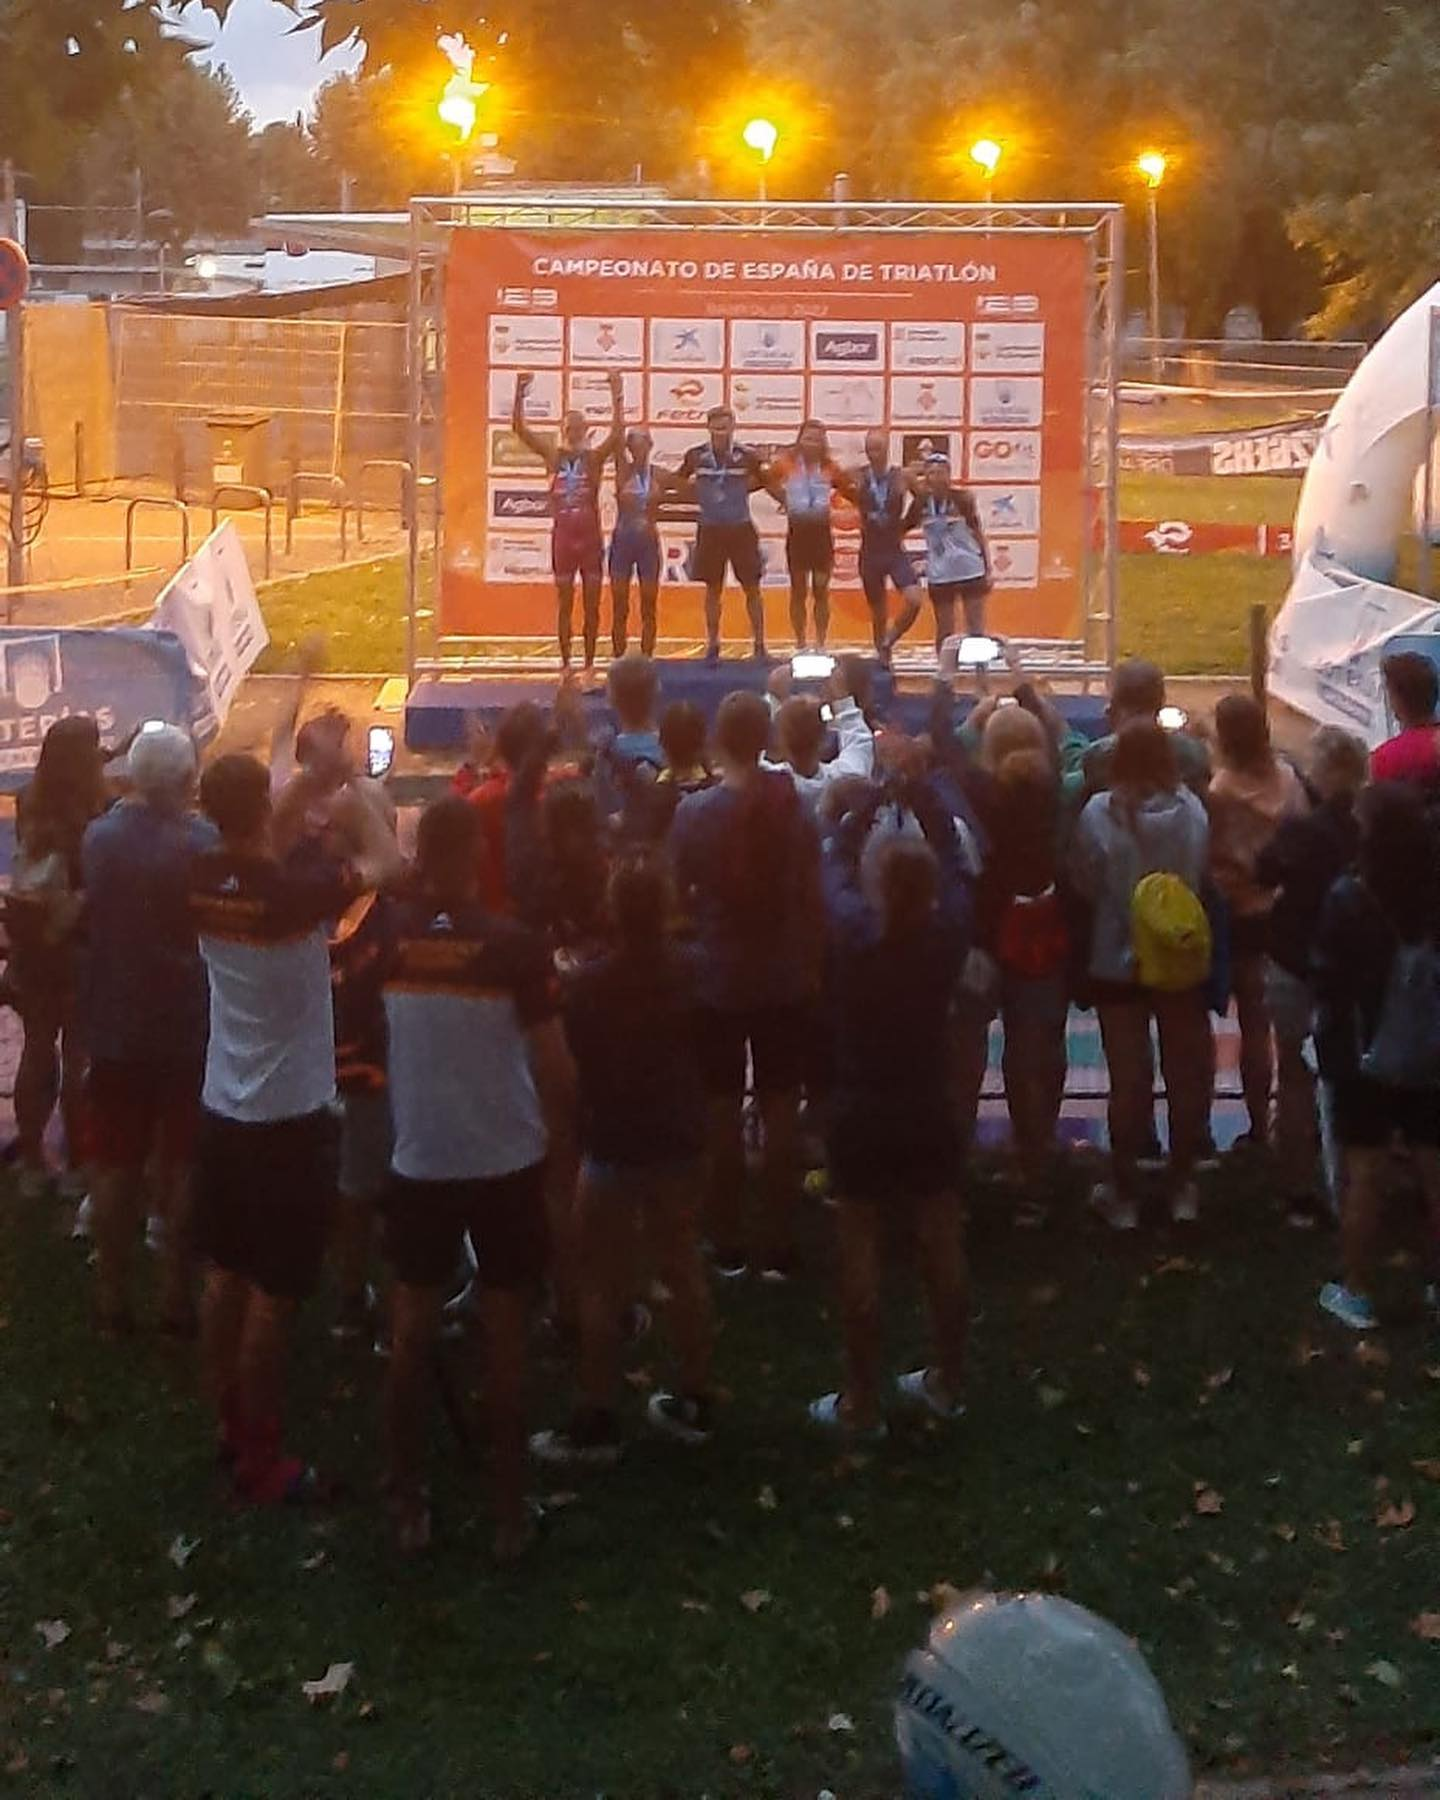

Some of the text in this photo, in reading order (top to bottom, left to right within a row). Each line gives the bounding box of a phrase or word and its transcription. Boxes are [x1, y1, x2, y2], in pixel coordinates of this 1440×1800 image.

[532, 256, 997, 283] CAMPEONATO DE ESPAÑA DE TRIATLÓN
